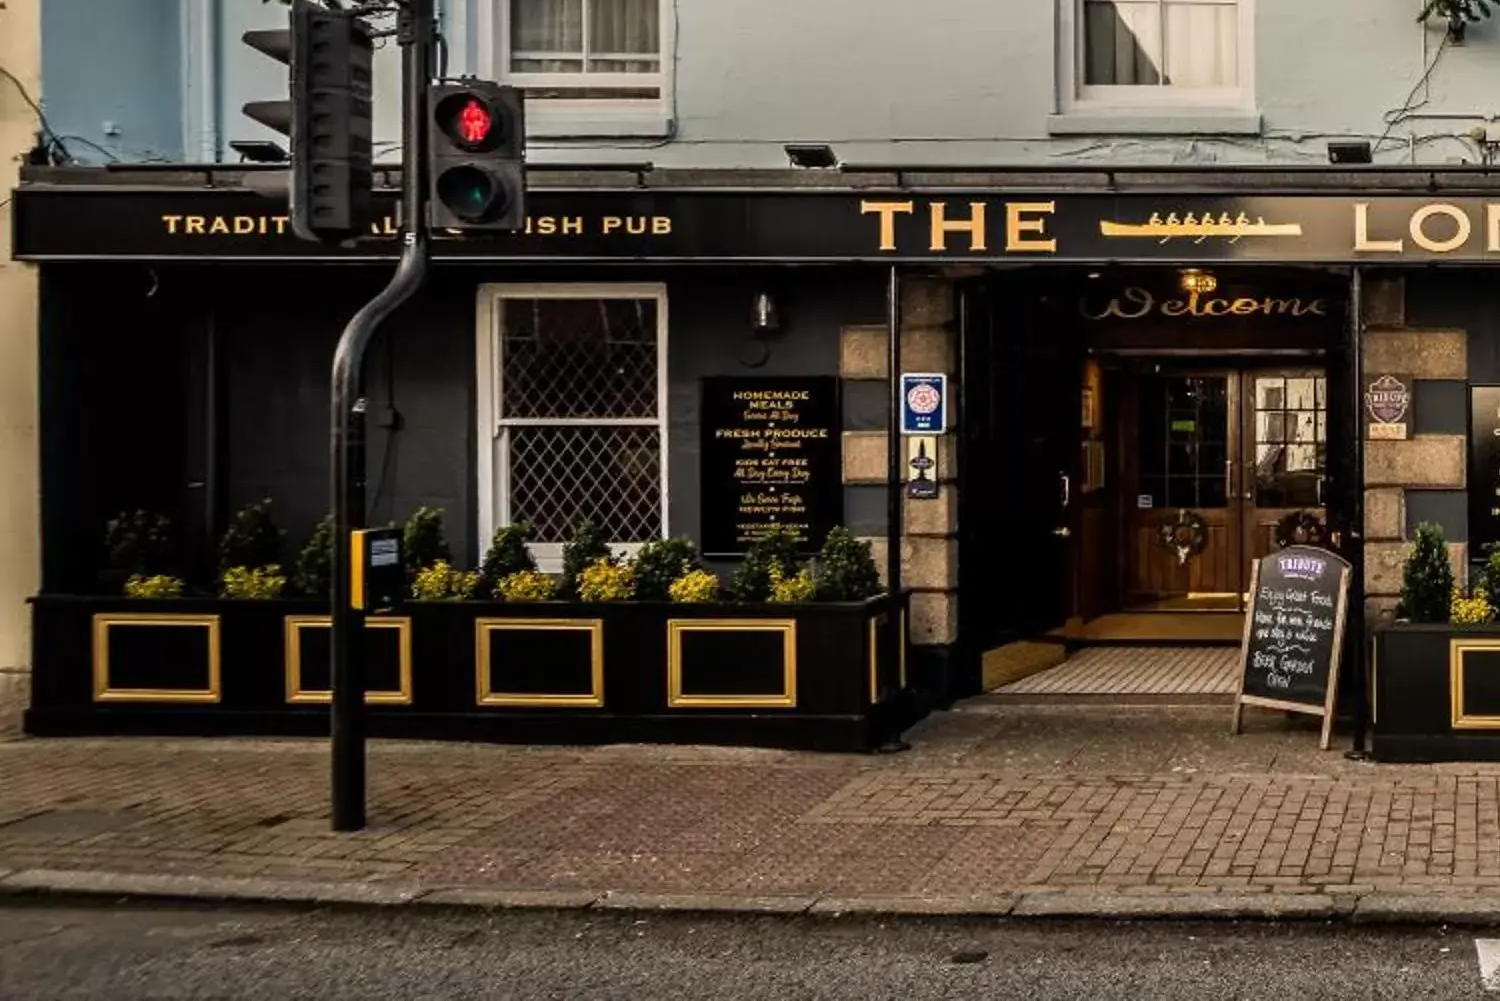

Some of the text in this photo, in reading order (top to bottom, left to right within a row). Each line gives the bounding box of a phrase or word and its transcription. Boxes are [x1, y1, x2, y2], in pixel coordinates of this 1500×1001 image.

[601, 216, 673, 235] PUB
[861, 200, 1057, 252] THE
[733, 391, 810, 400] HOMEMADE
[749, 400, 794, 410] MEALS
[715, 429, 829, 438] FRESH PRODUCE
